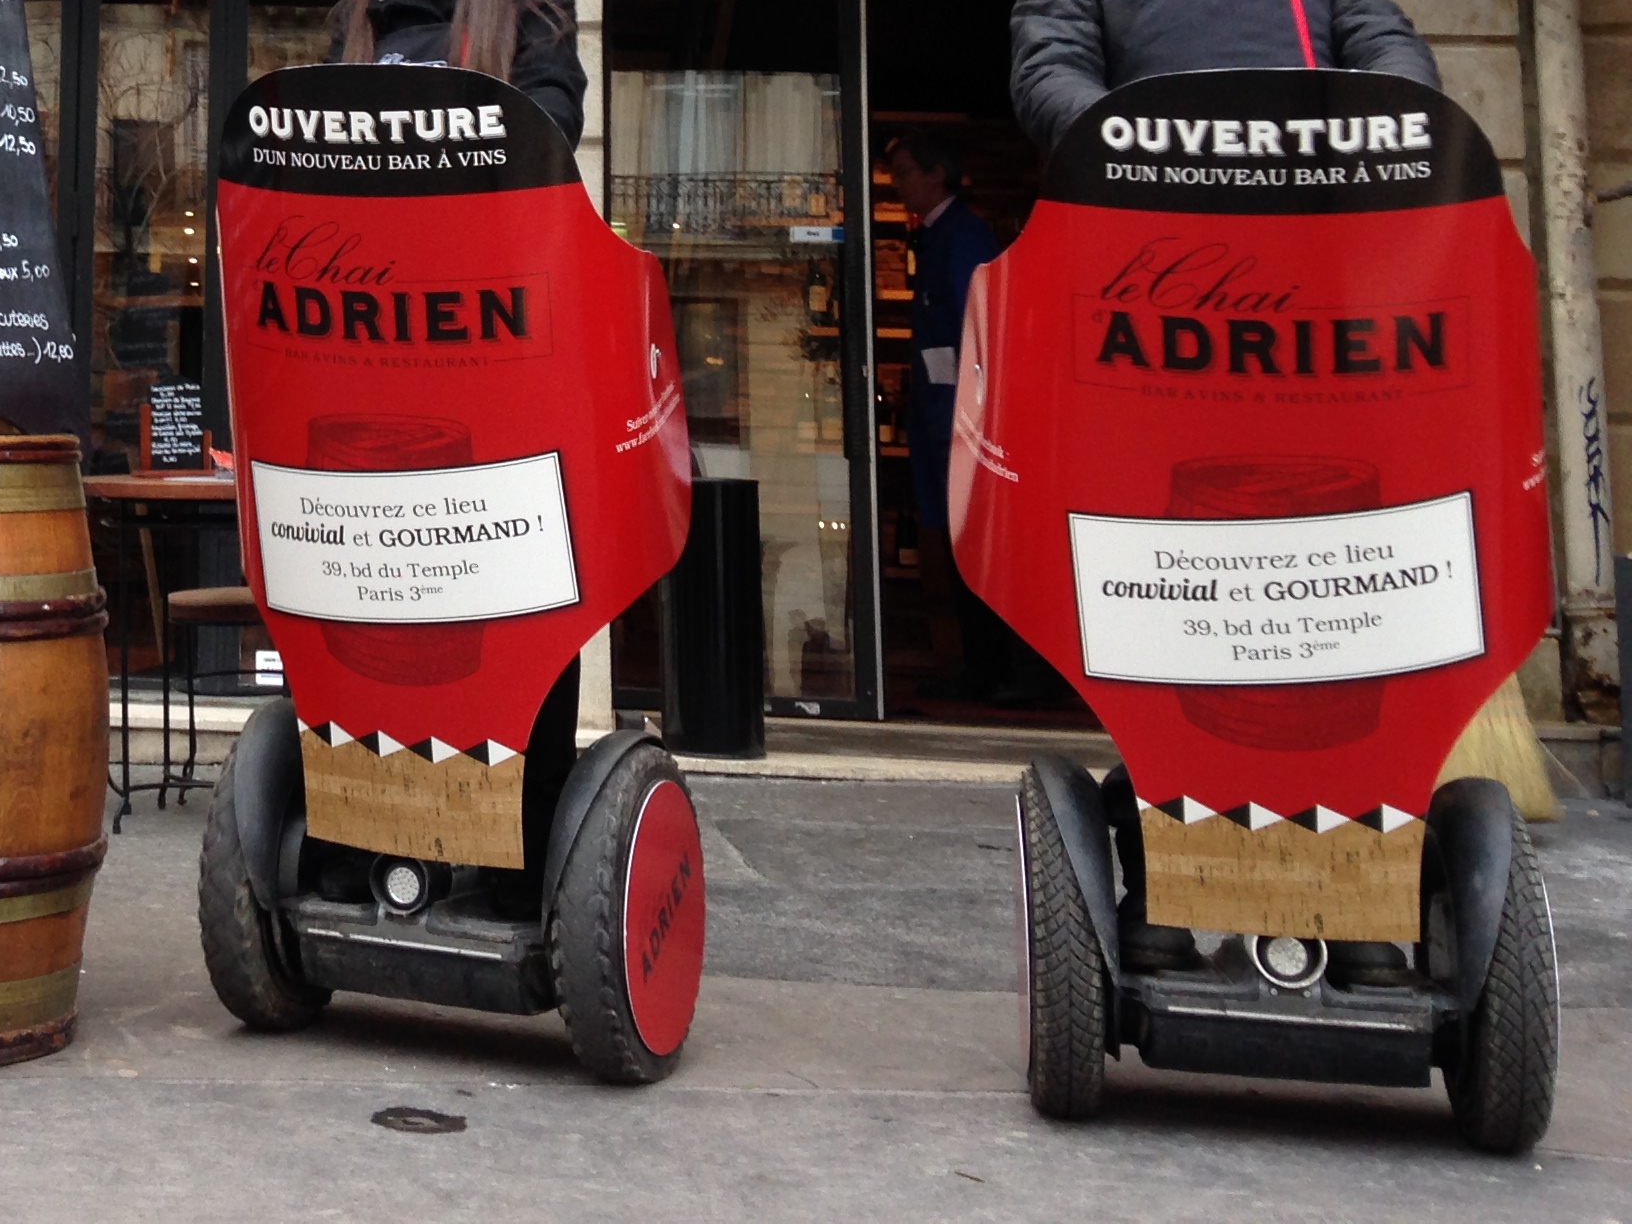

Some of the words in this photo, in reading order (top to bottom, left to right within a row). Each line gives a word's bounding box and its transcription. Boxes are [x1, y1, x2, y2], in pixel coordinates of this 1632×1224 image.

[0, 103, 35, 127] 10,50
[248, 104, 508, 145] OUVERTURE
[1101, 111, 1432, 157] OUVERTURE
[290, 151, 382, 171] NOUVEAU
[387, 153, 432, 170] BAR
[437, 148, 454, 169] À
[457, 149, 507, 166] VINS
[1163, 165, 1287, 186] NOUVEAU
[1294, 166, 1346, 186] BAR
[1352, 161, 1372, 184] À
[1378, 161, 1432, 181] VINS
[278, 215, 397, 285] Chai
[21, 259, 50, 283] 5,00
[1141, 237, 1300, 313] Chai
[256, 281, 532, 346] ADRIEN
[1096, 310, 1447, 376] ADRIEN
[299, 496, 405, 519] Découvrez
[412, 500, 437, 517] ce
[443, 496, 488, 515] lieu
[271, 521, 346, 546] convivial
[352, 530, 373, 547] et
[378, 517, 531, 548] GOURMAND
[349, 561, 373, 579] bd
[378, 562, 403, 579] du
[406, 559, 480, 581] Temple
[1154, 549, 1299, 571] Découvrez
[1307, 551, 1336, 567] ce
[1344, 543, 1395, 564] lieu
[357, 585, 404, 602] Paris
[1101, 578, 1219, 602] convivial
[1228, 585, 1255, 603] et
[1263, 563, 1439, 603] GOURMAND
[1223, 618, 1254, 637] bd
[1260, 617, 1292, 635] du
[1298, 611, 1383, 637] Temple
[1231, 643, 1293, 662] Paris
